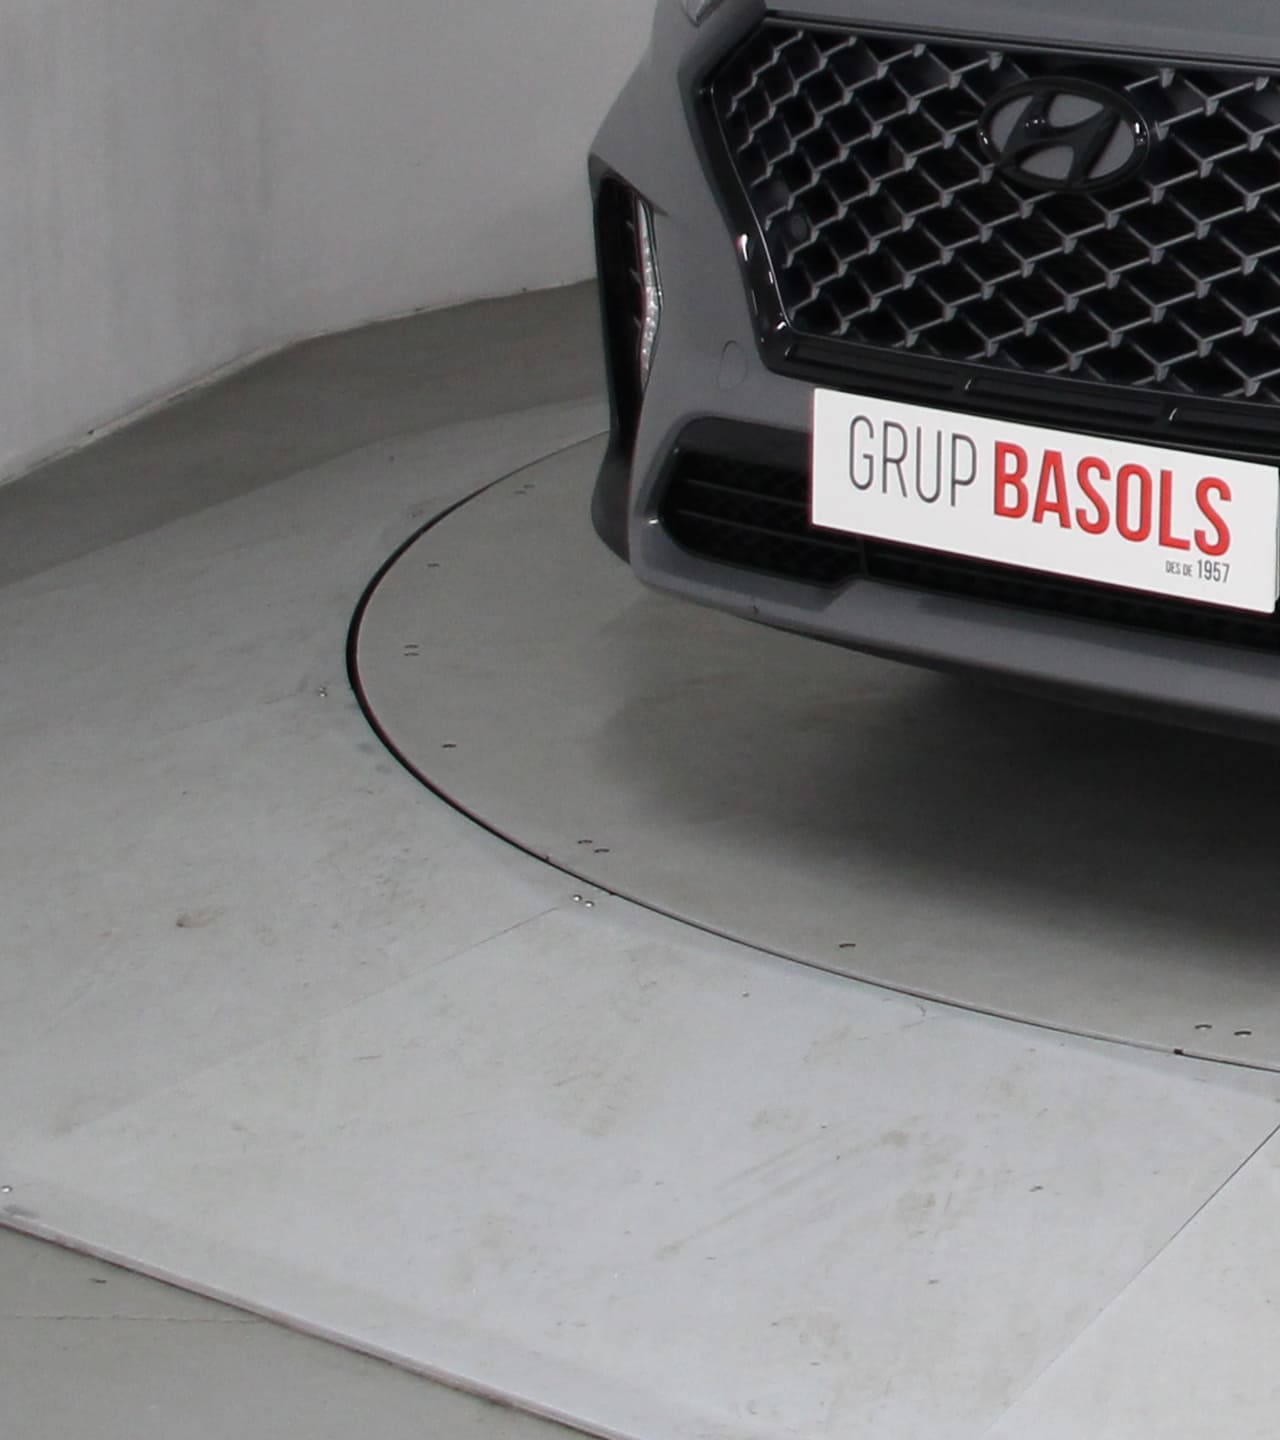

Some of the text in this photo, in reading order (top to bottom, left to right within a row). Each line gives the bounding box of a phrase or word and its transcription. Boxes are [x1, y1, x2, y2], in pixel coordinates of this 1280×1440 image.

[849, 414, 1232, 557] GRUP BASOLS
[1197, 559, 1230, 583] 1957
